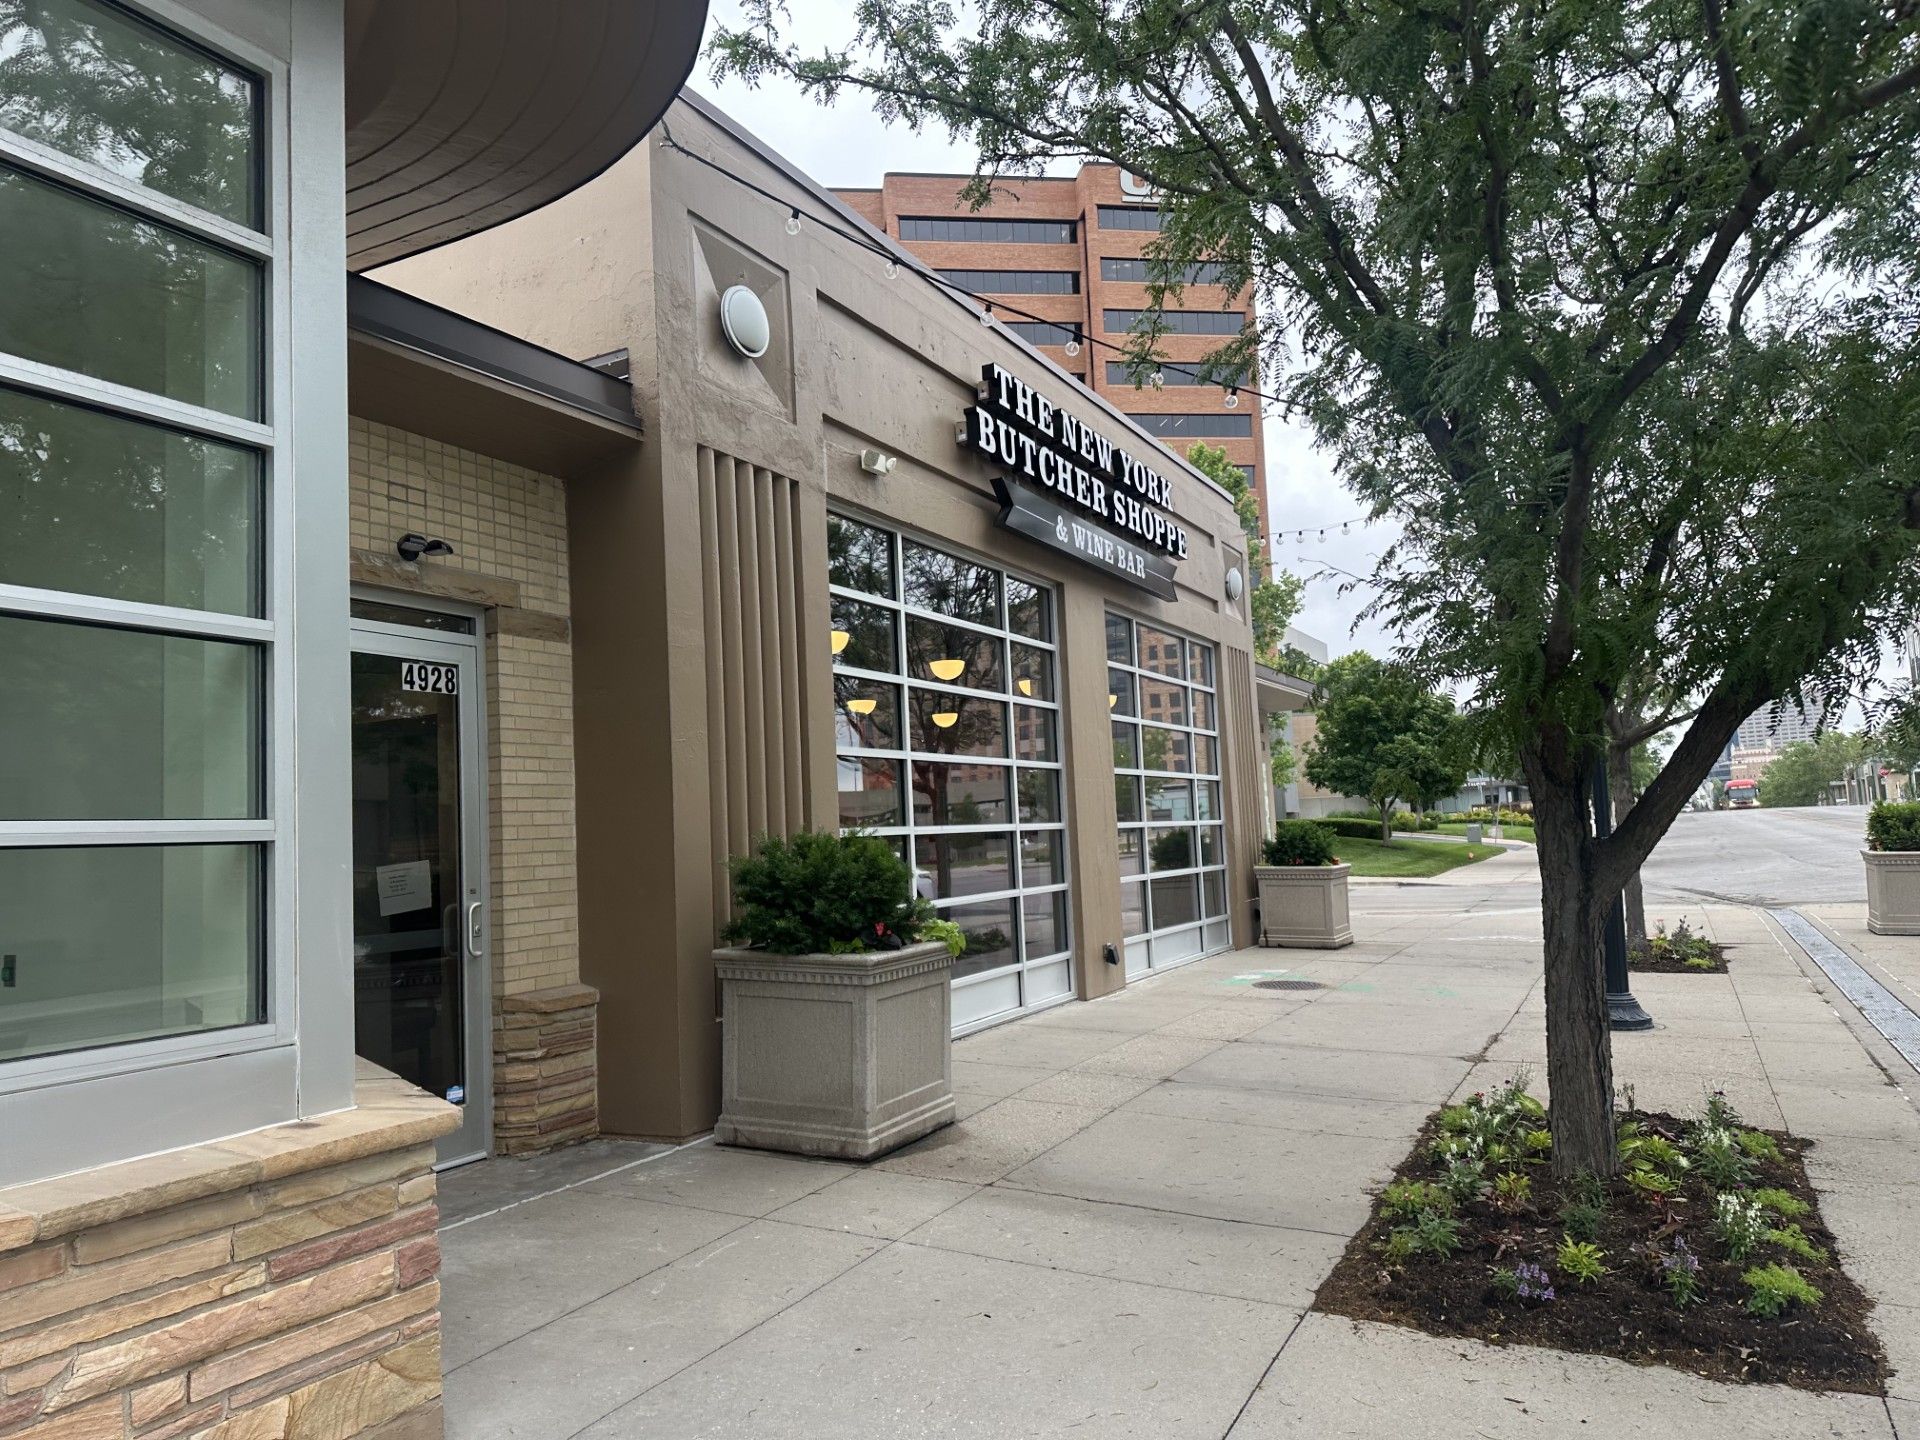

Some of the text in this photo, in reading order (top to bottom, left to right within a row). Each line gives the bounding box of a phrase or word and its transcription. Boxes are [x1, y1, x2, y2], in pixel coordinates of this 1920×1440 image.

[975, 406, 1188, 560] BUTCHER SHOPPE
[993, 363, 1174, 512] THE NEW YORK
[1055, 515, 1146, 579] & WINE BAR
[404, 664, 456, 693] 4928
